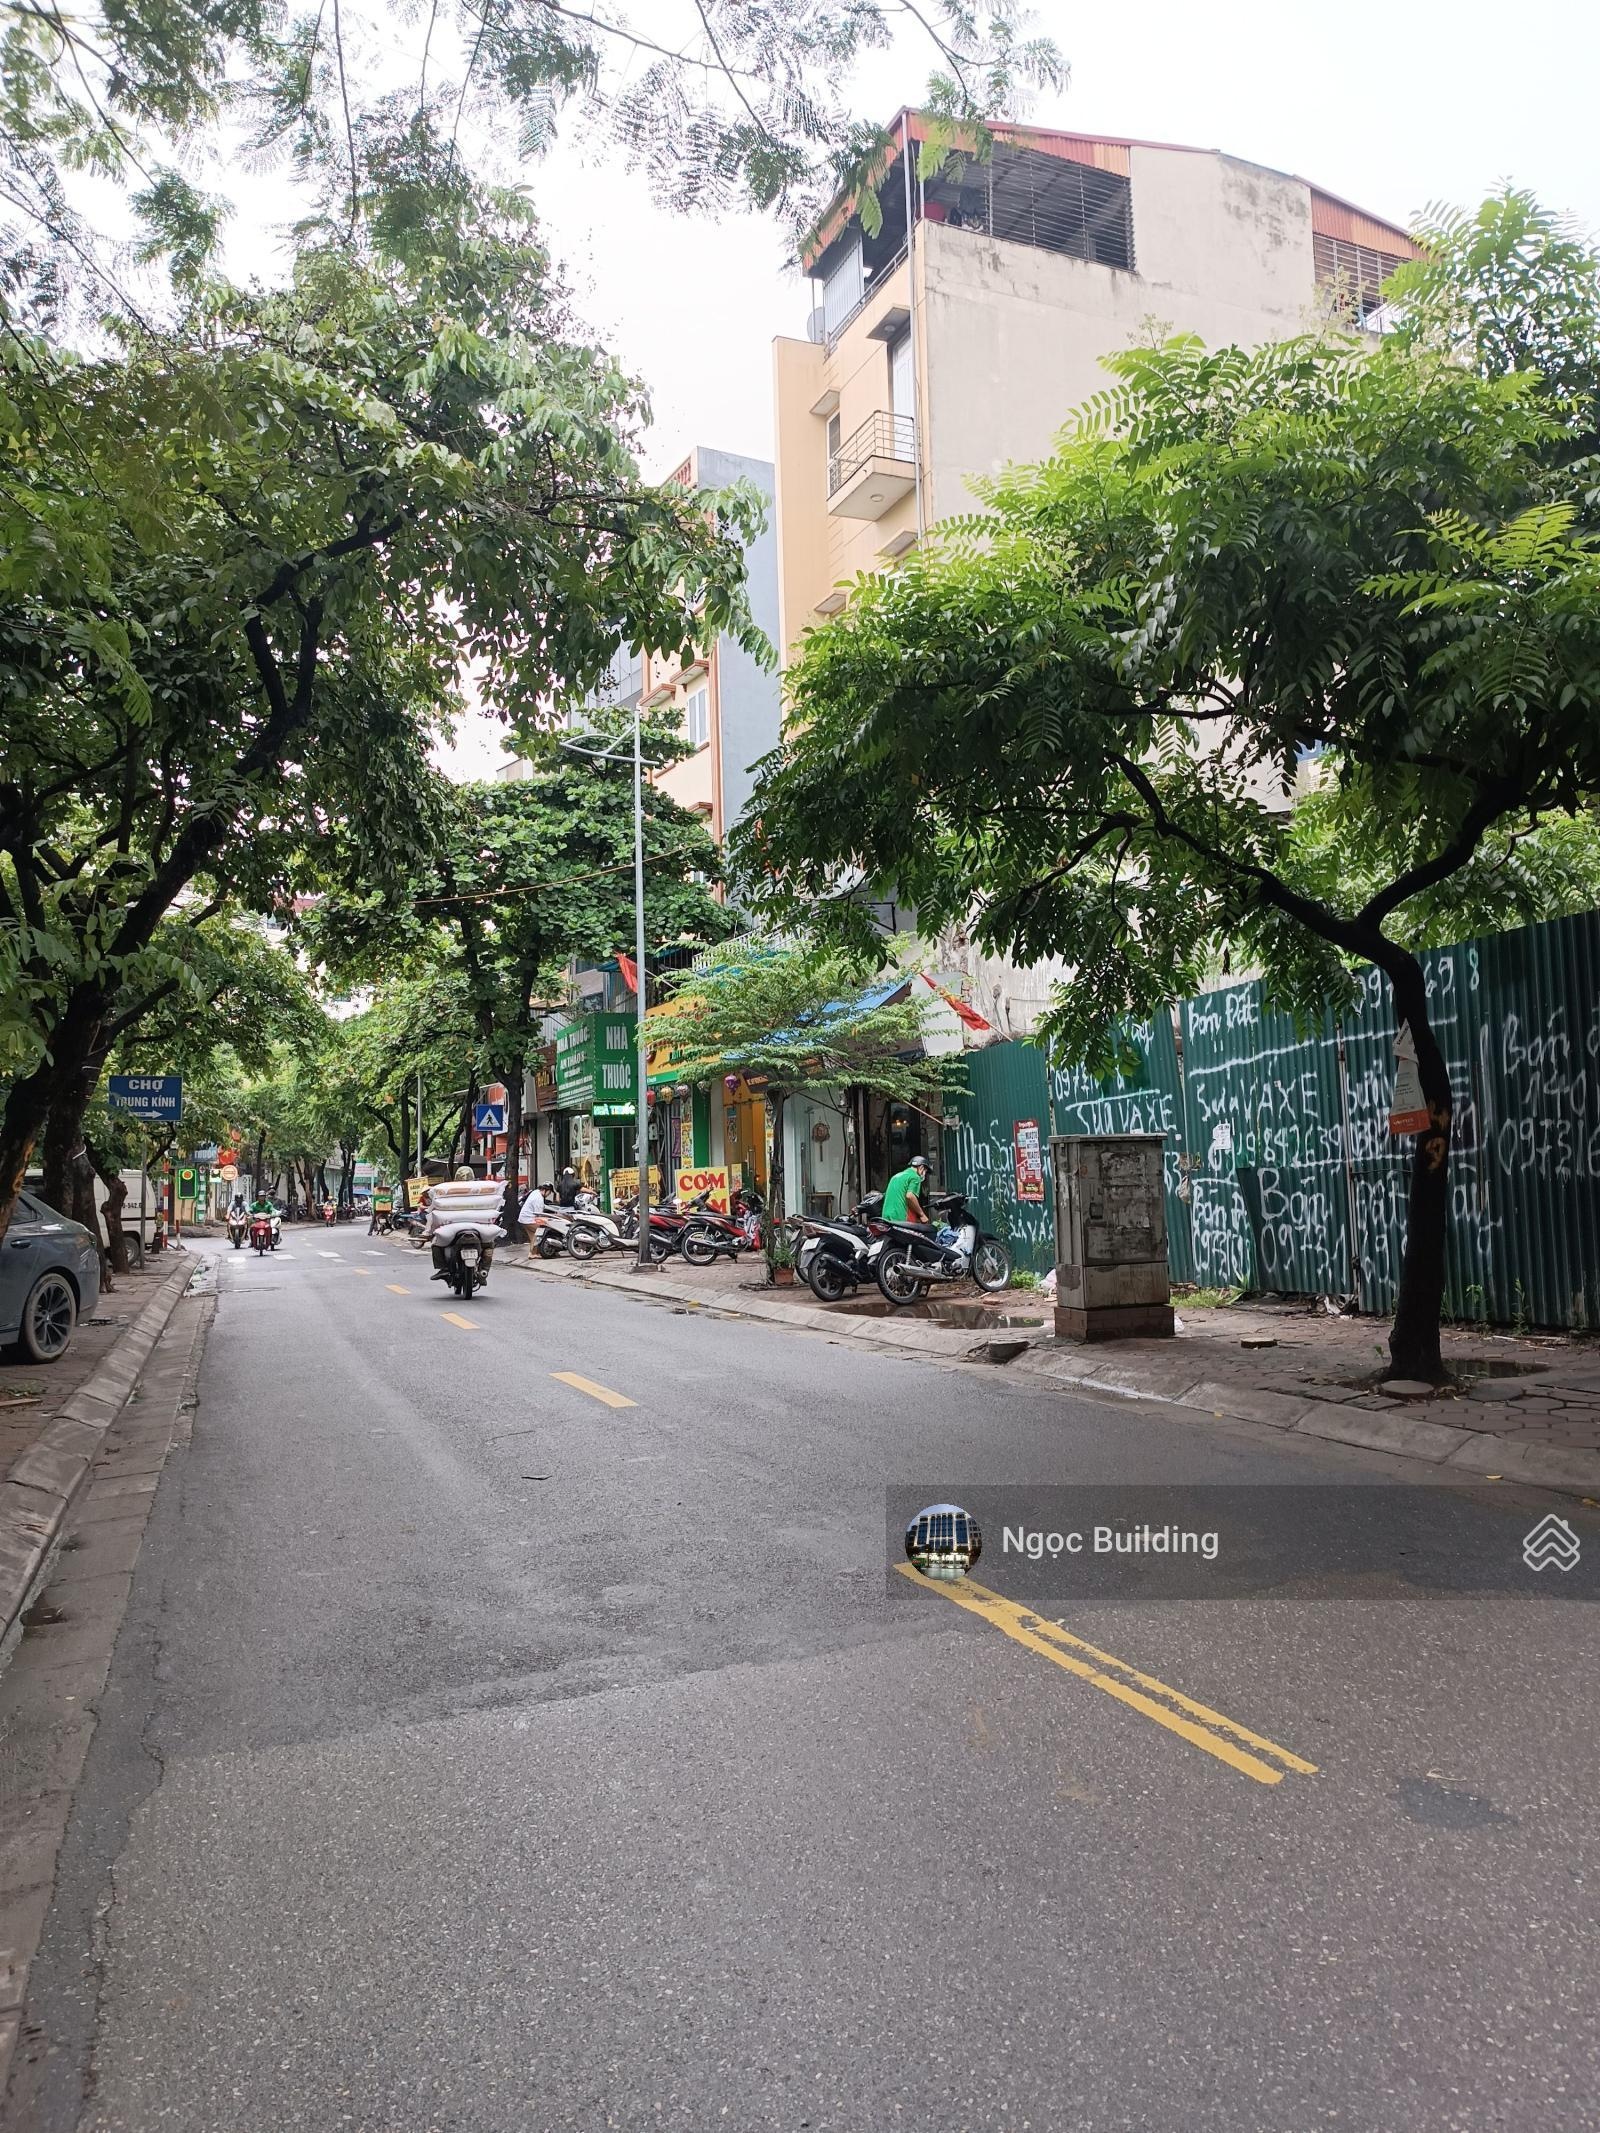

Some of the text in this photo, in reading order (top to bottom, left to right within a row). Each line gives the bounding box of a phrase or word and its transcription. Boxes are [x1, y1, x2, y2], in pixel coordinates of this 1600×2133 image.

[606, 1023, 629, 1050] NHÀ
[602, 1056, 632, 1089] THUỐC
[128, 1079, 165, 1093] CHỢ
[116, 1094, 176, 1107] TRUNG KÍNH
[680, 1171, 726, 1191] CƠM
